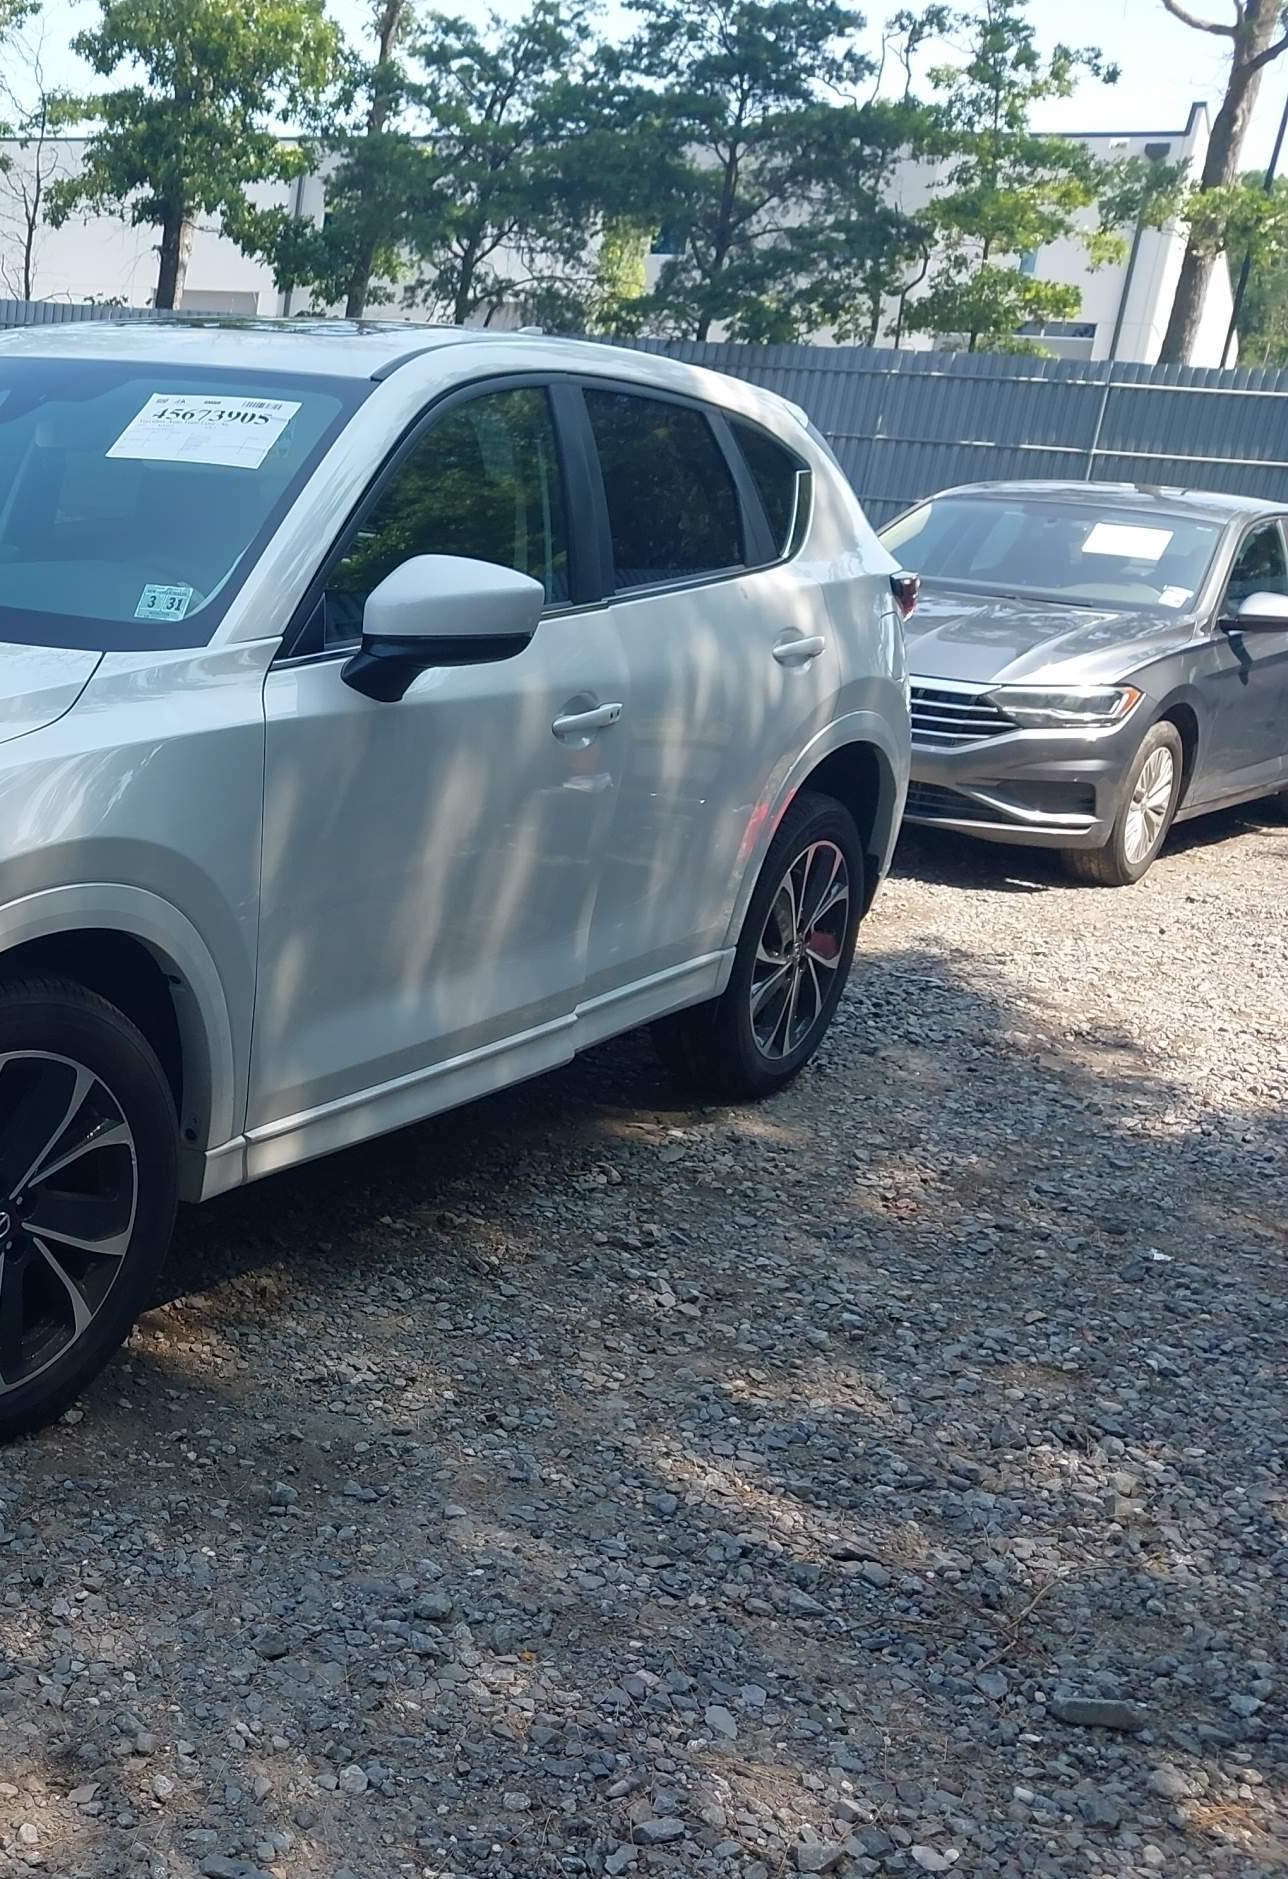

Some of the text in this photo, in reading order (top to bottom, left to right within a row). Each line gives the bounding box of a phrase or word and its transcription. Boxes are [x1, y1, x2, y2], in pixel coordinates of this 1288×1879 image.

[152, 408, 273, 425] 45673905
[147, 595, 184, 611] 3 31
